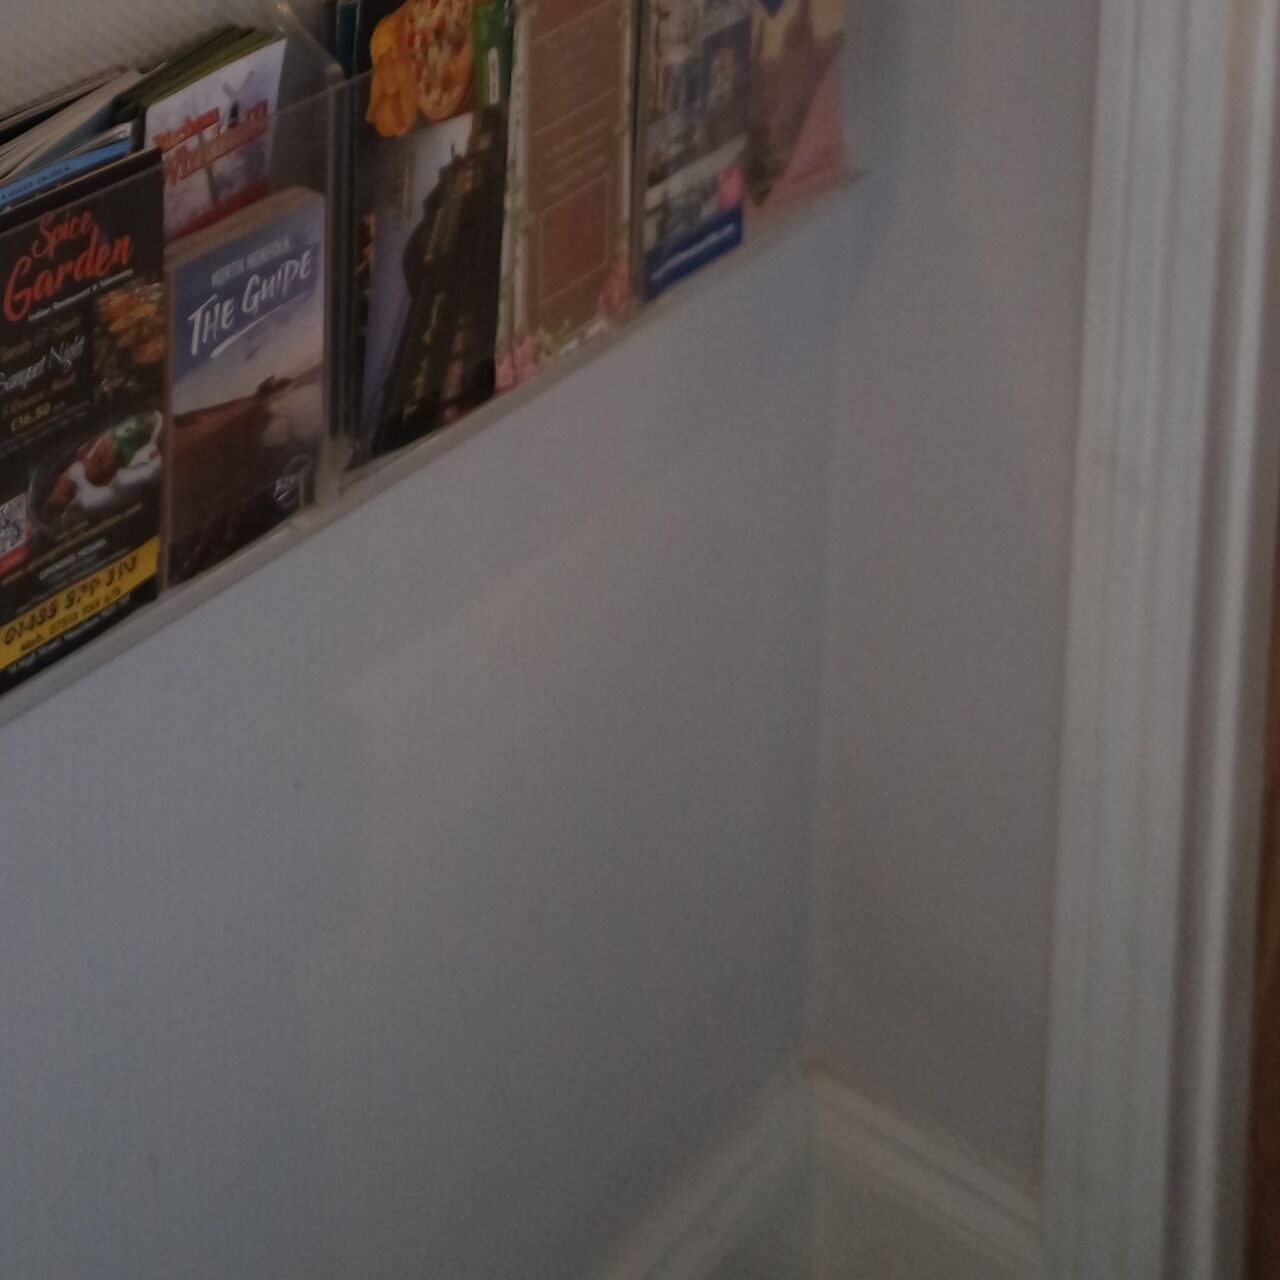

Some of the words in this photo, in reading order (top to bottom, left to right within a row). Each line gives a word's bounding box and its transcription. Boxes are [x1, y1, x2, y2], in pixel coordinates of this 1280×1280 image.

[3, 230, 132, 322] Garden
[30, 209, 94, 260] Spice
[188, 294, 234, 356] THE
[241, 250, 312, 314] GUIDE
